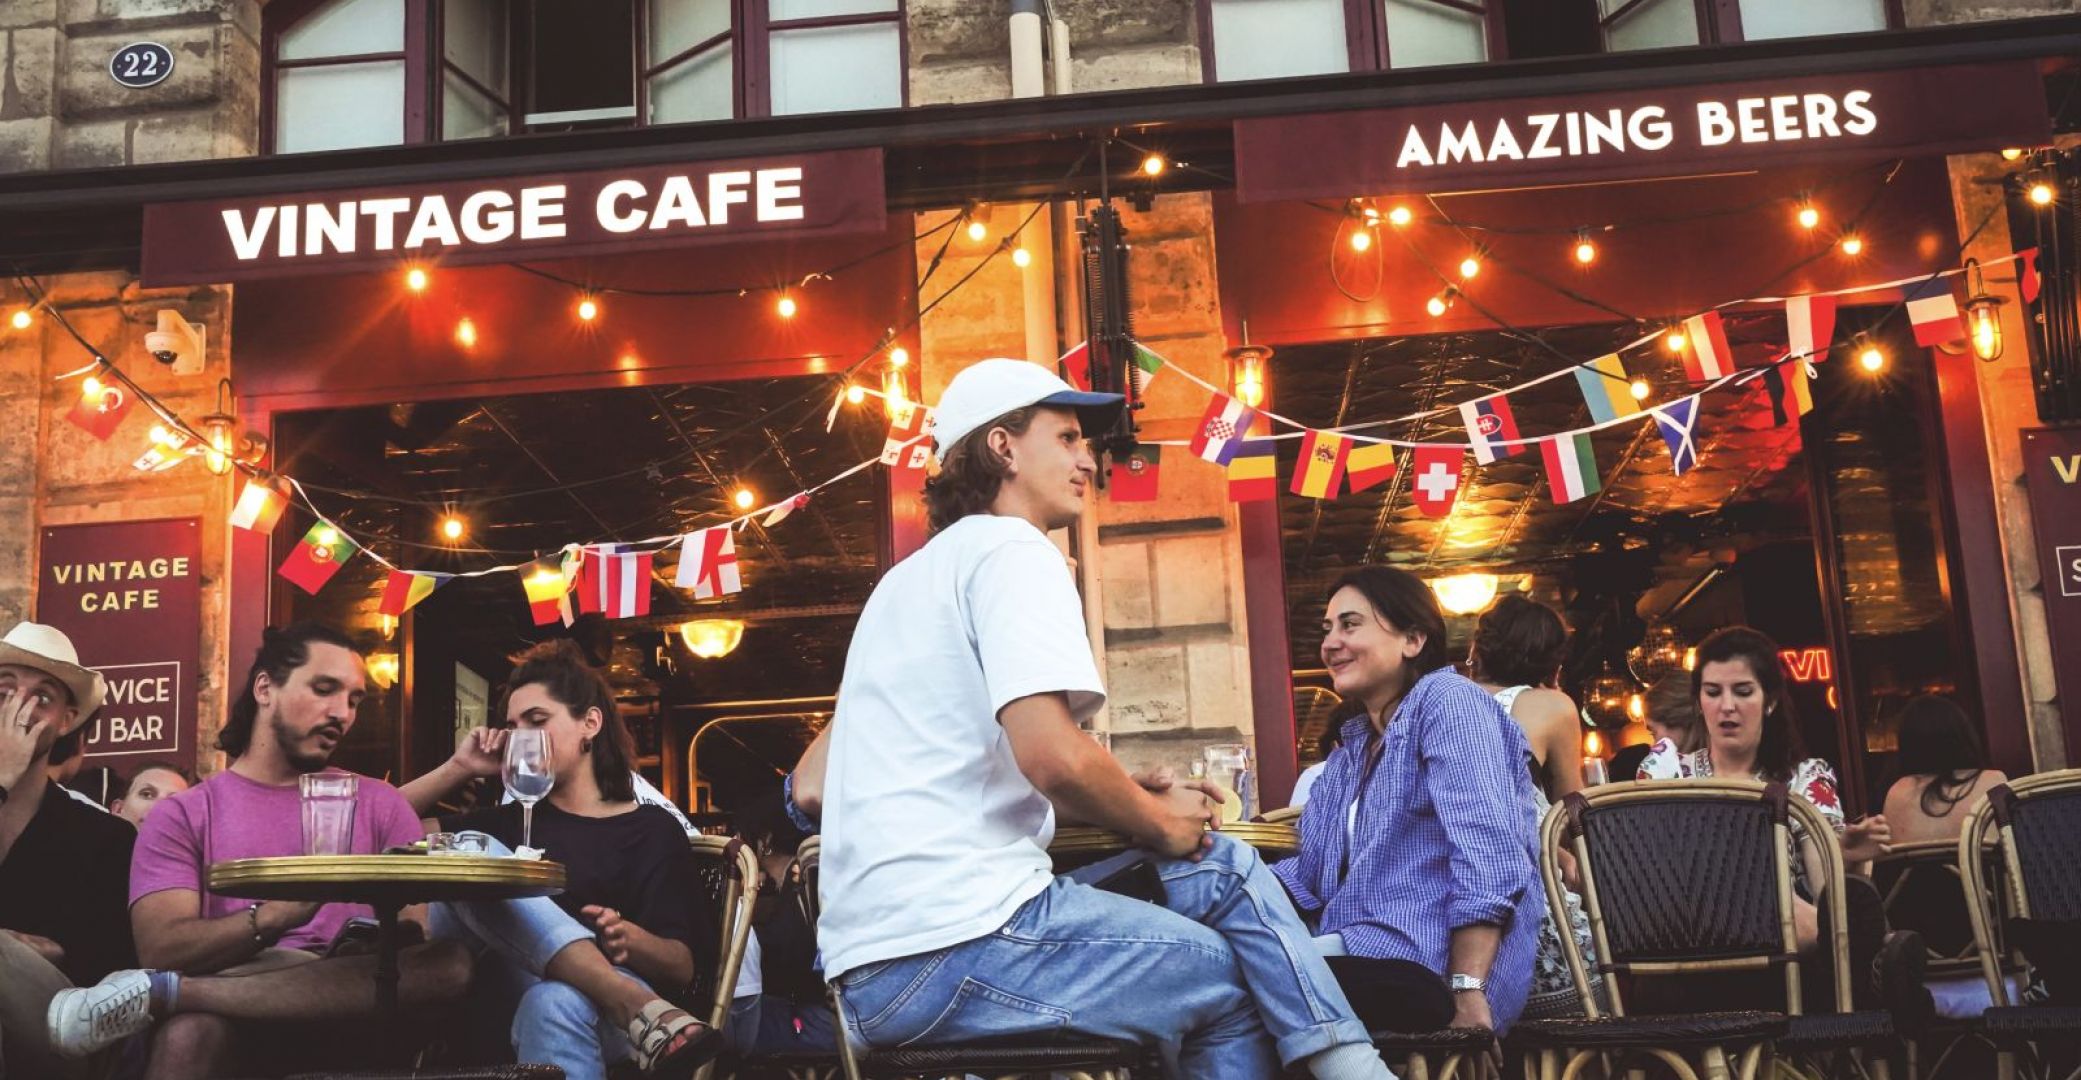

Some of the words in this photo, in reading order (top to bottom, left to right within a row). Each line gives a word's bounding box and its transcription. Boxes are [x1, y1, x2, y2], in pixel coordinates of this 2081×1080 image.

[124, 50, 158, 77] 22
[1396, 105, 1673, 168] AMAZING
[1696, 90, 1877, 146] BEERS
[221, 185, 567, 260] VINTAGE
[596, 167, 804, 233] CAFE
[53, 557, 190, 584] VINTAGE
[81, 589, 160, 612] CAFE
[102, 677, 170, 706] VICE
[110, 715, 163, 743] BAR
